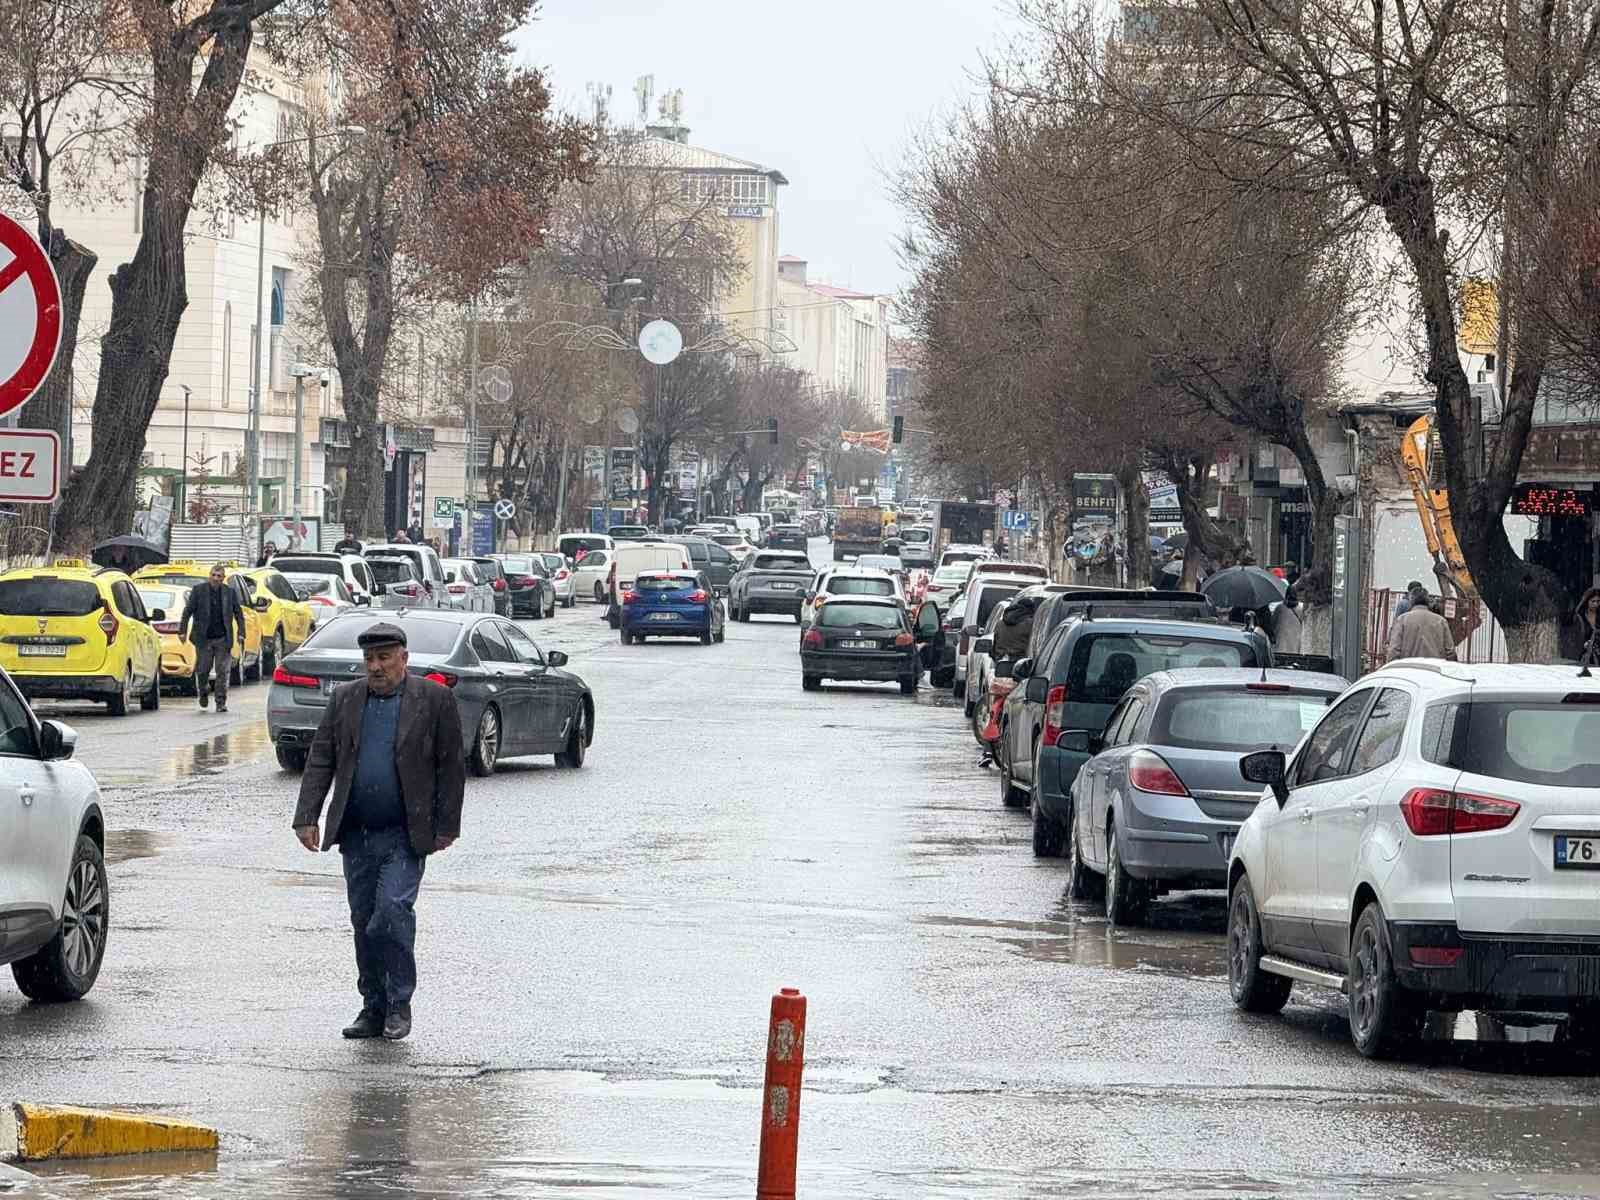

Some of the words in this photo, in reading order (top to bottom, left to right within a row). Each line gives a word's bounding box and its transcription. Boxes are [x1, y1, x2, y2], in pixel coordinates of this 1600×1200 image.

[0, 452, 35, 477] EZ
[1077, 497, 1116, 507] BENFIT
[1568, 840, 1593, 860] 76
